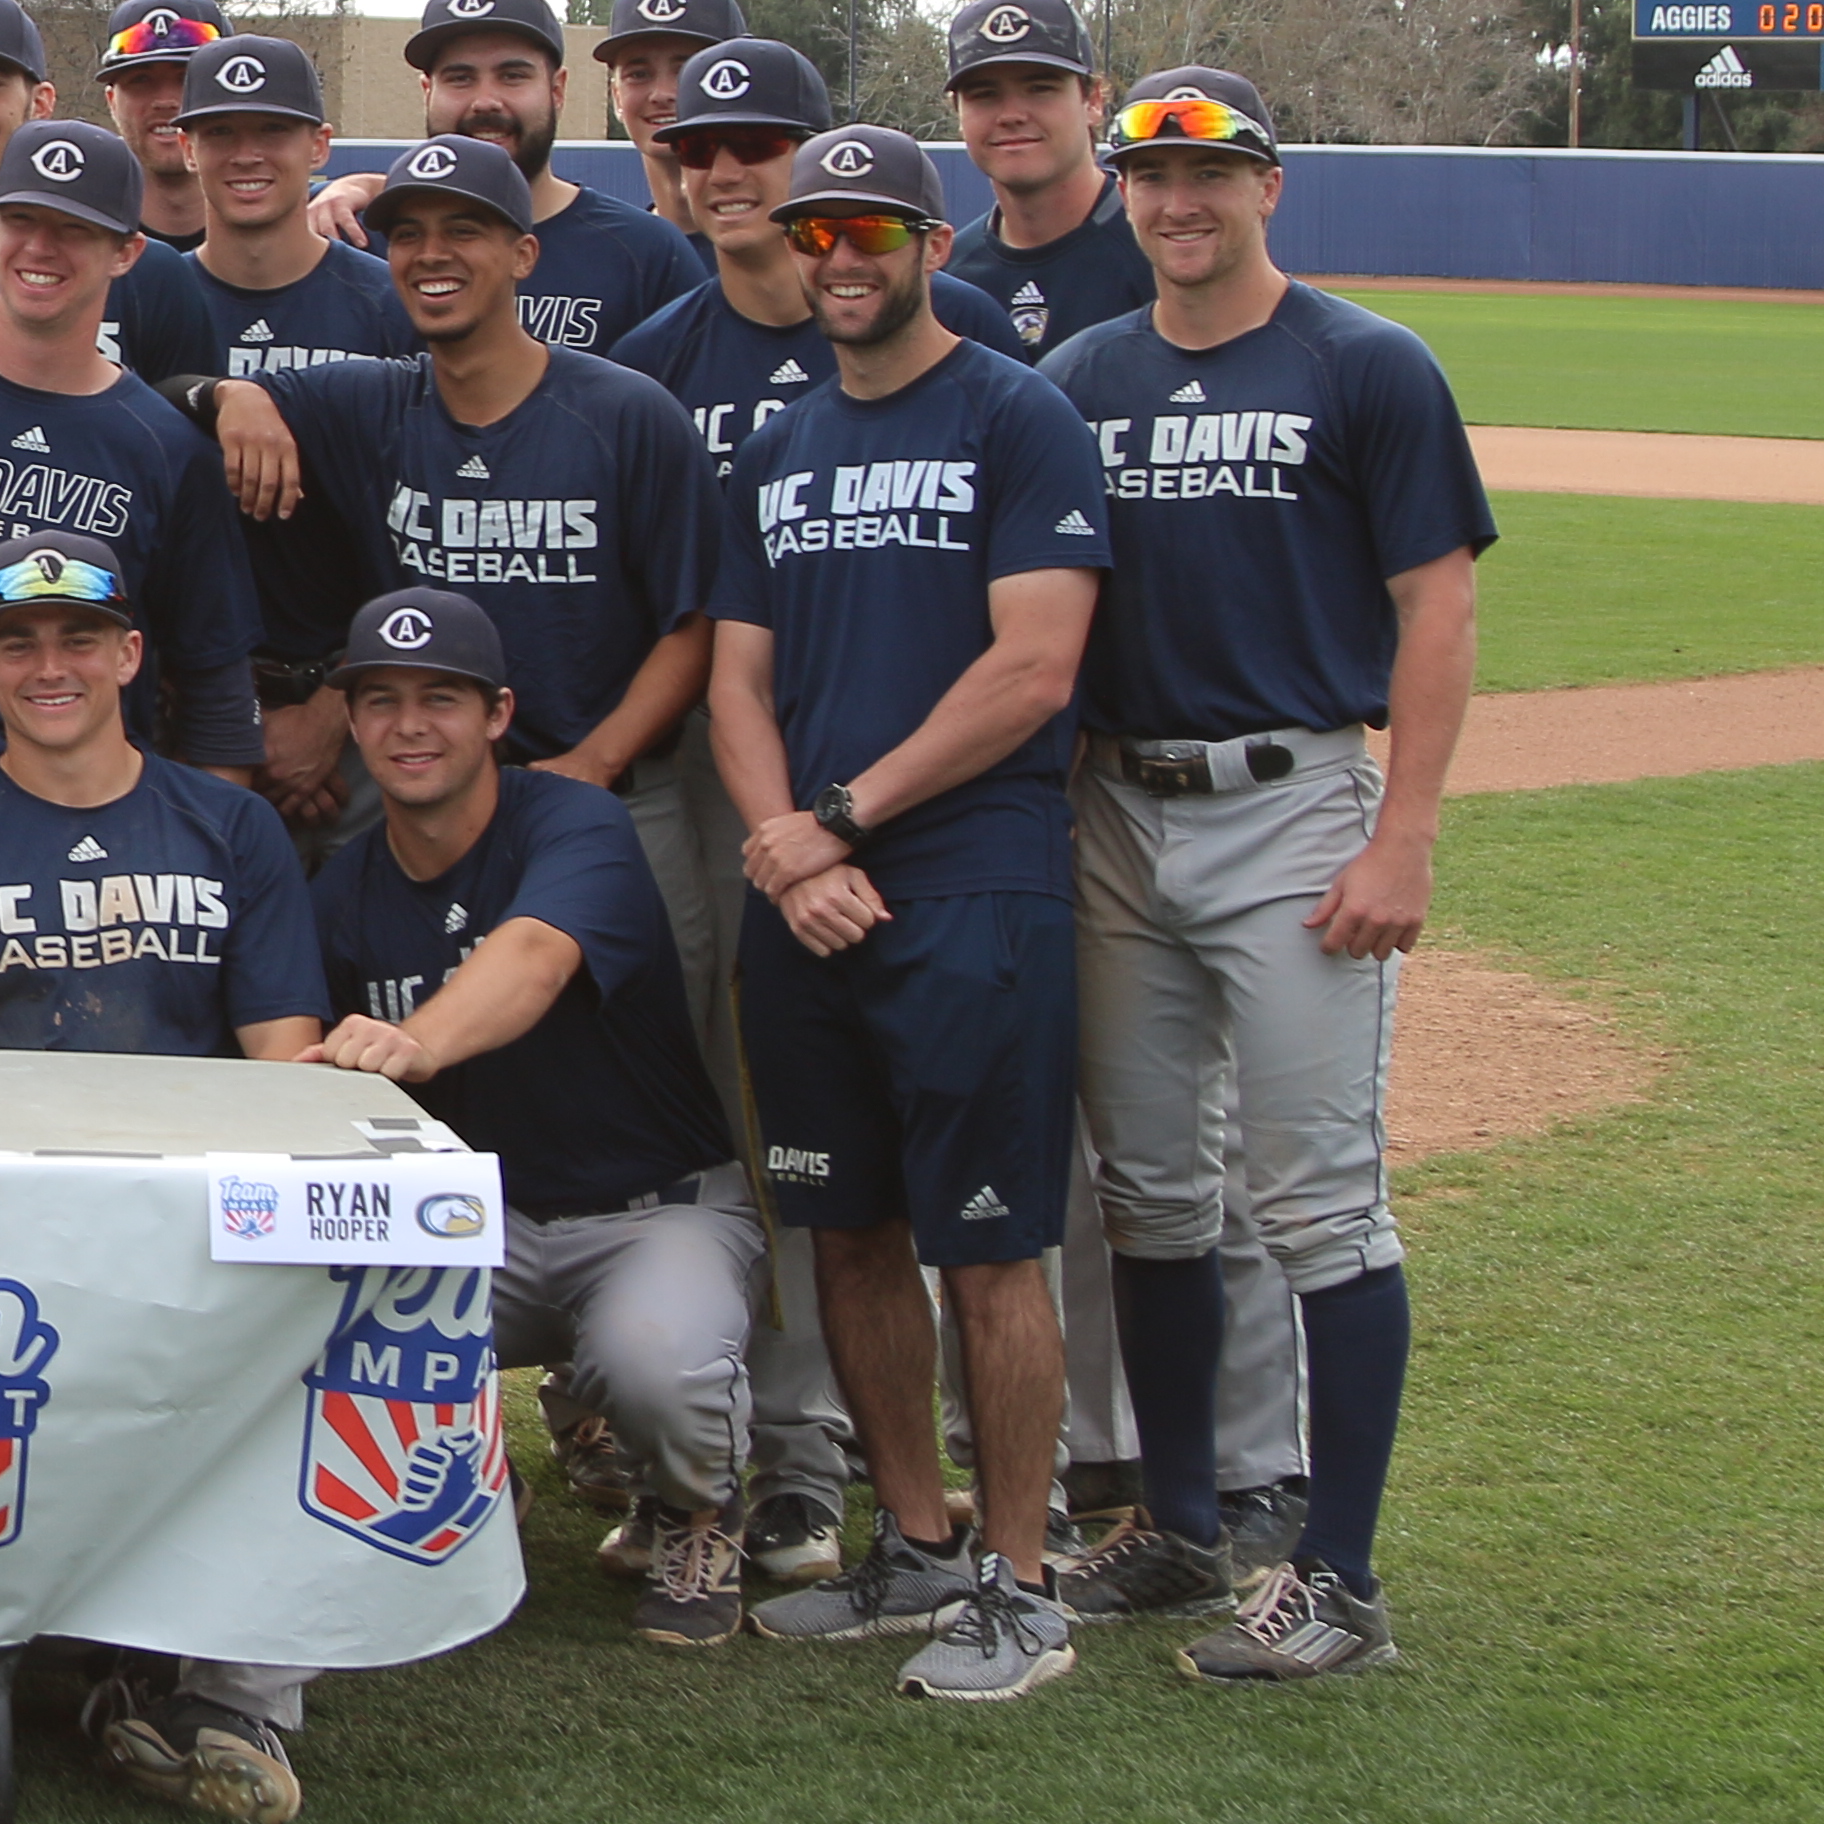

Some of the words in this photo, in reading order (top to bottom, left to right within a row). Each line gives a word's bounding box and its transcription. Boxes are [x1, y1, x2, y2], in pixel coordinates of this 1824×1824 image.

[1652, 5, 1732, 31] AGGIES
[1695, 72, 1752, 88] adidas
[516, 296, 602, 347] VIS
[1150, 411, 1313, 466] DAVIS
[758, 471, 815, 532] UC
[831, 460, 977, 514] DAVIS
[442, 499, 597, 550] DAVIS
[59, 873, 231, 934] DAVIS
[768, 1146, 831, 1177] DAVIS
[219, 1175, 279, 1203] Team
[306, 1182, 391, 1218] RYAN
[962, 1204, 1010, 1222] adidas
[310, 1219, 391, 1242] HOOPER
